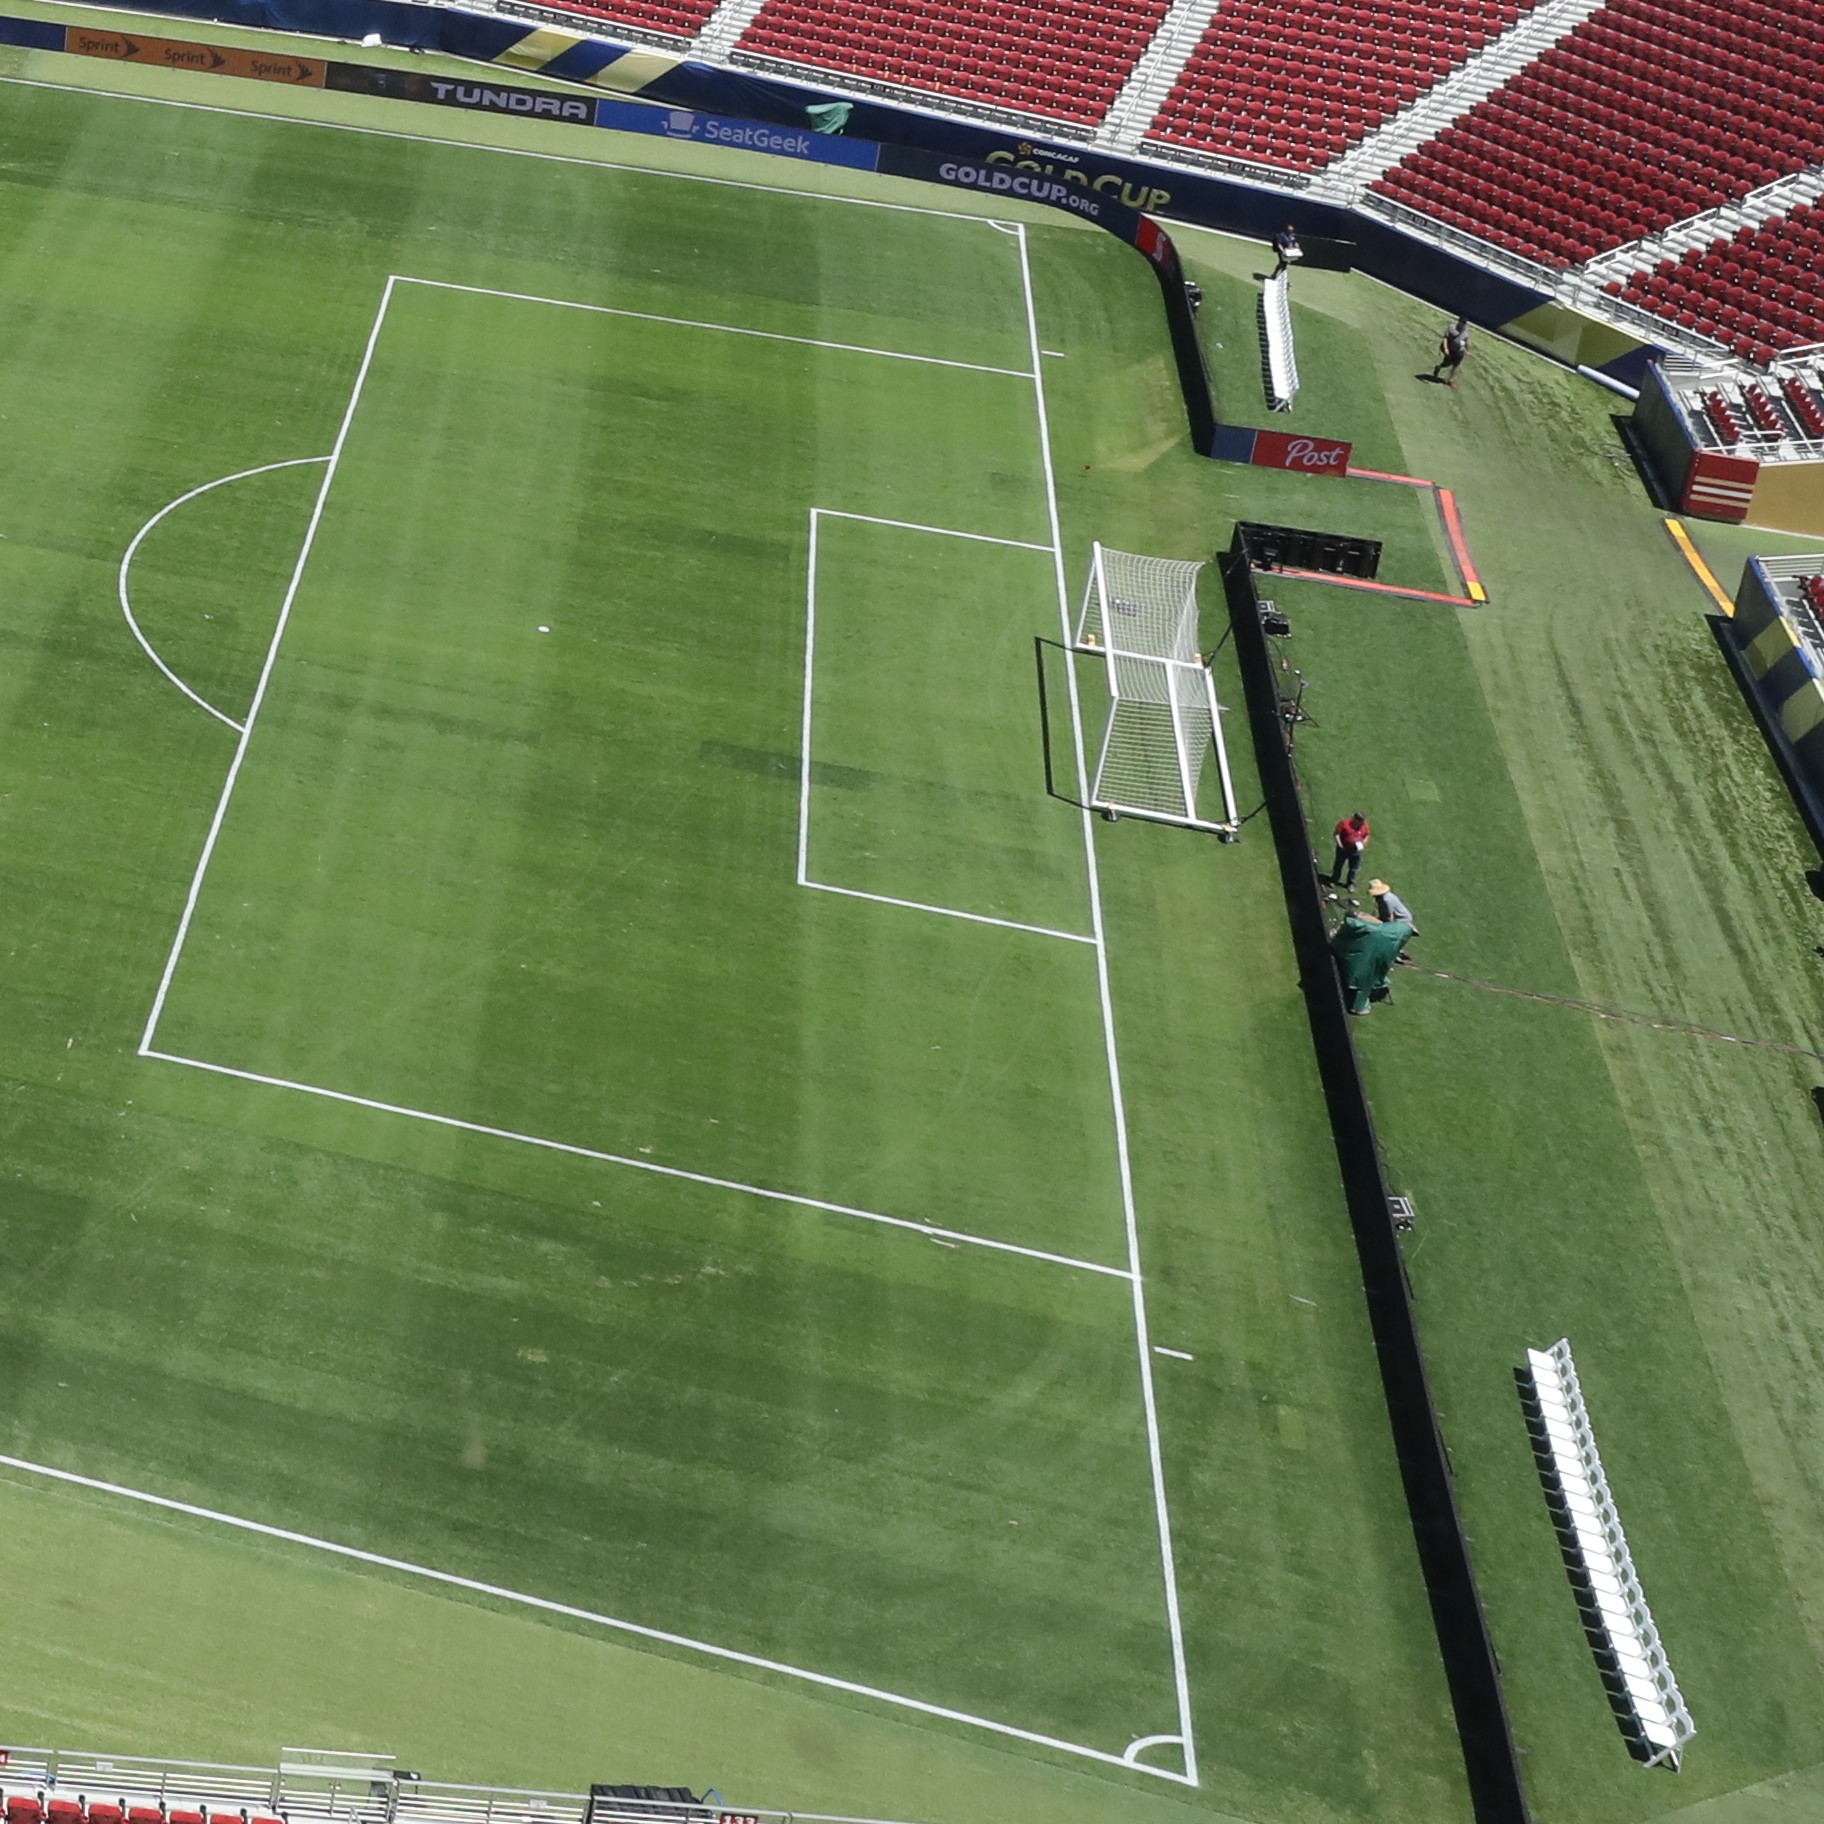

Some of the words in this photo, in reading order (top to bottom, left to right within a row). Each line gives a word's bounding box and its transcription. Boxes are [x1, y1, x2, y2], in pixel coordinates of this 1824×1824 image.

[79, 36, 120, 54] Sprint
[164, 47, 206, 66] Sprint
[250, 59, 292, 77] Sprint
[430, 81, 588, 119] TUNDRA
[704, 120, 811, 154] SeatGeek
[939, 162, 1099, 216] GOLDCUP.ORG
[1285, 439, 1344, 468] Post
